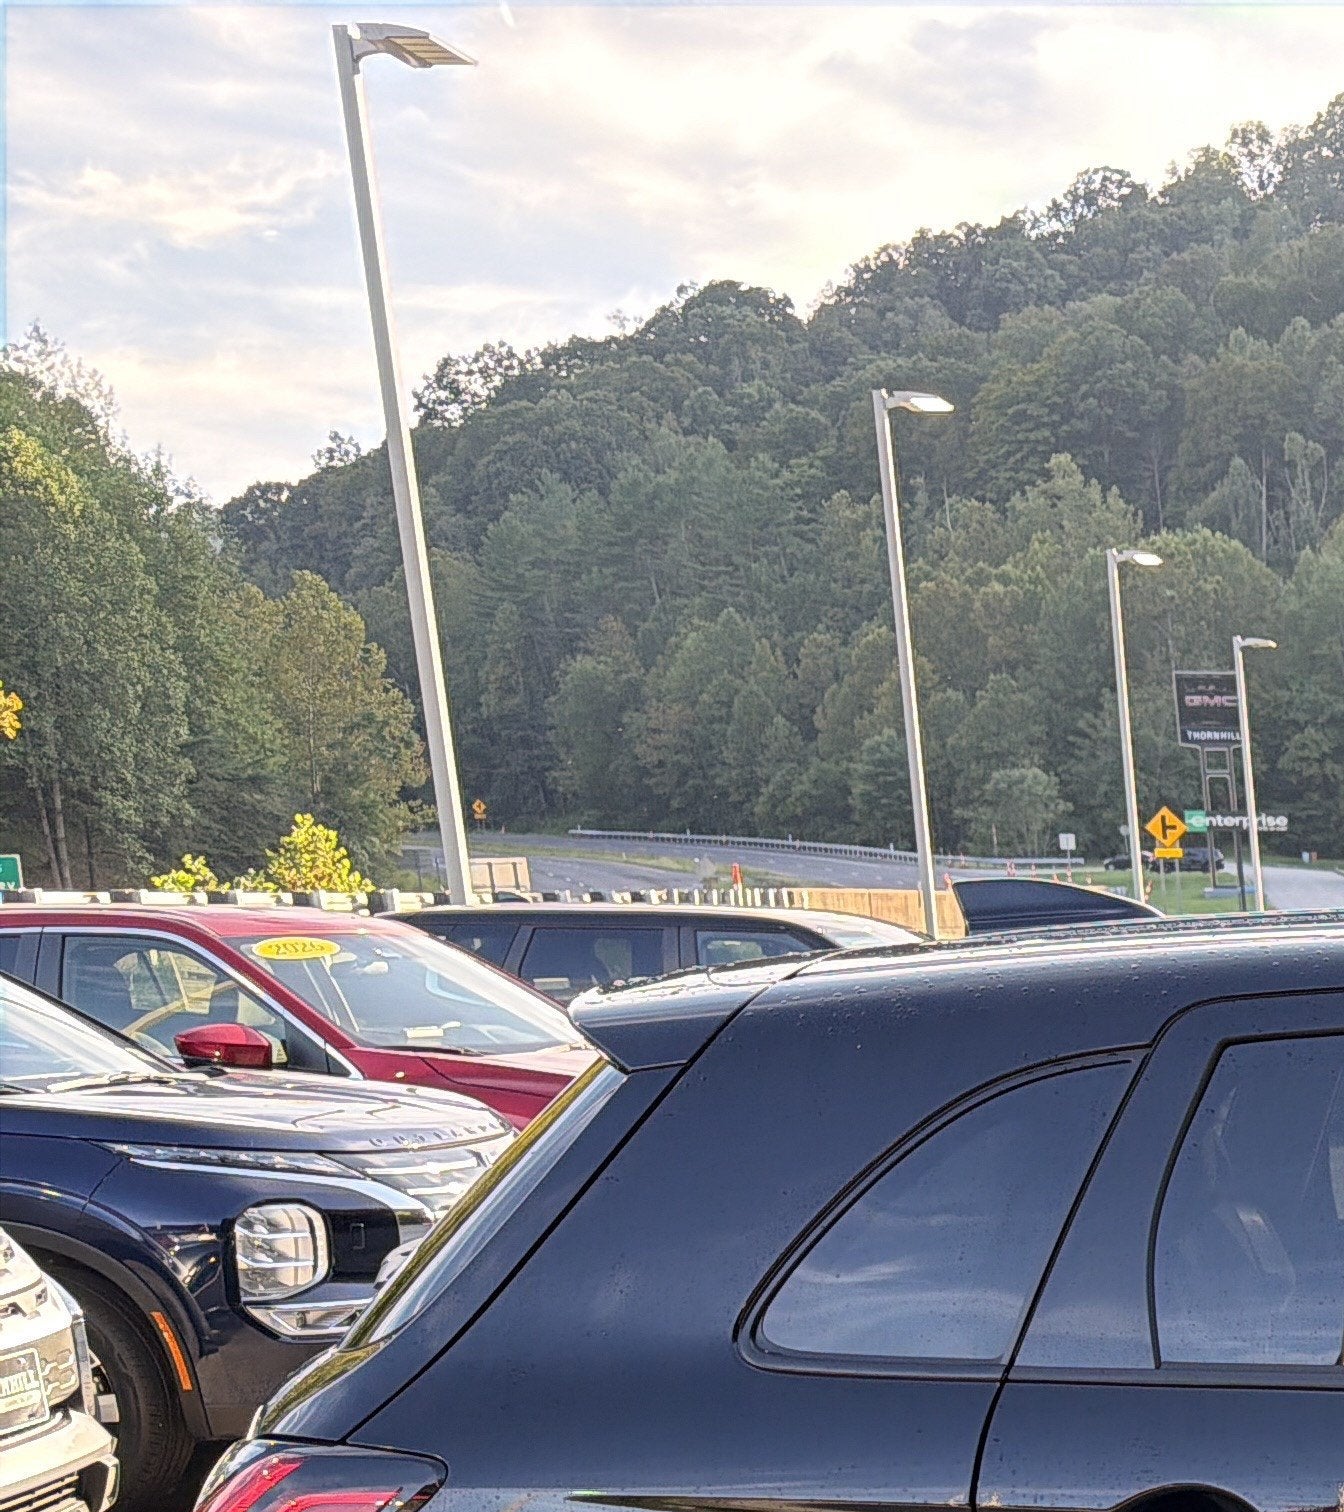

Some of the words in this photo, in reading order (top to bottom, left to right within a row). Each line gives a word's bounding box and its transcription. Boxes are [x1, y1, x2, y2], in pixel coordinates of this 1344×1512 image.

[1184, 695, 1239, 707] GMC
[1186, 729, 1242, 741] THORNHILL
[1190, 812, 1289, 831] enterpise
